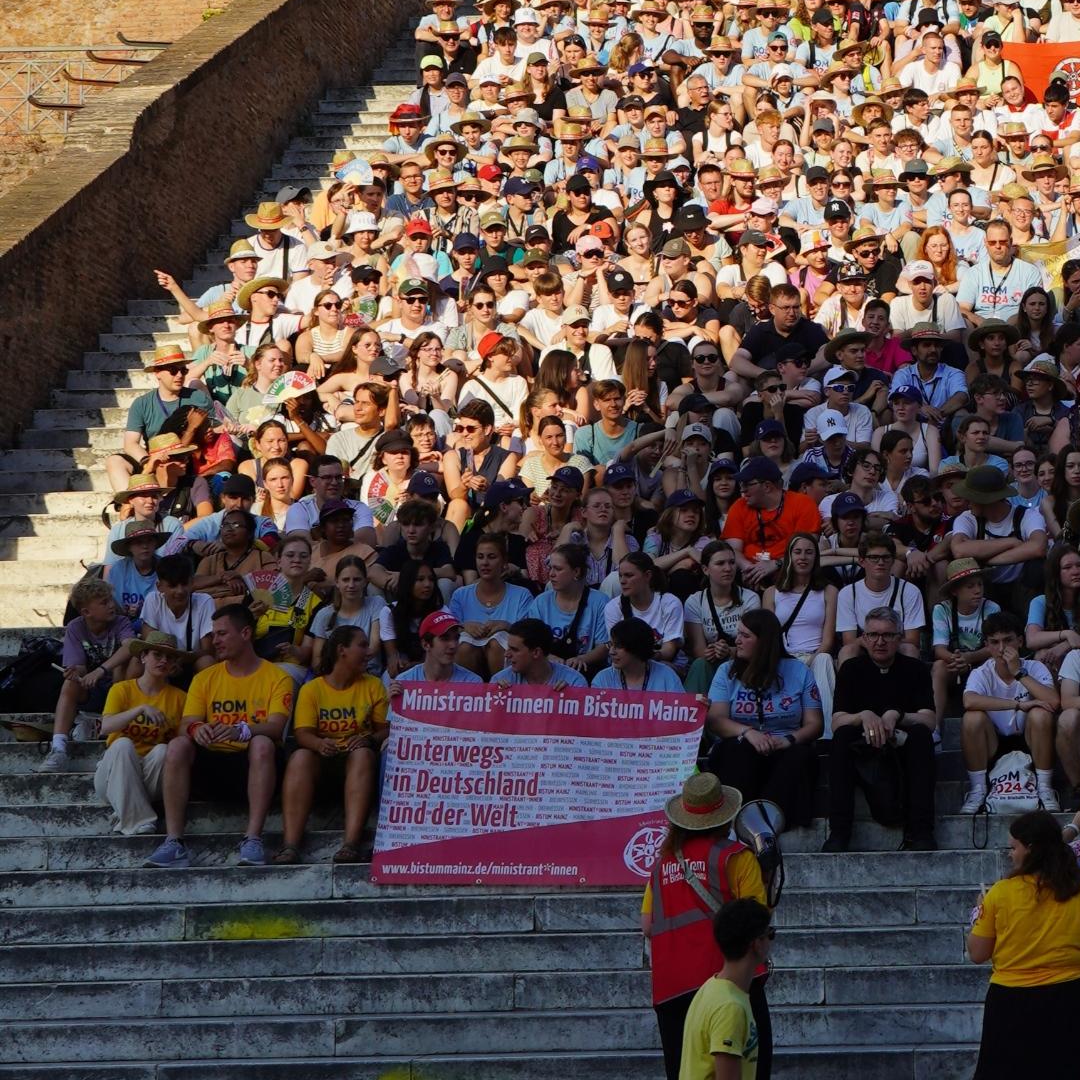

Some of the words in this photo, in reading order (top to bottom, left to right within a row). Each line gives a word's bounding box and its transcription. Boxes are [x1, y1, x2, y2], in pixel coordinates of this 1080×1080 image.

[212, 700, 247, 713] ROM
[558, 693, 579, 716] im
[584, 695, 645, 720] Bistum
[648, 699, 699, 723] Mainz
[736, 701, 774, 714] 204
[212, 713, 249, 726] 2024
[320, 707, 357, 720] ROM
[320, 720, 359, 733] 2024
[397, 737, 505, 769] Unterwegs
[393, 767, 411, 792] in
[416, 769, 538, 797] Deutschland
[388, 800, 427, 825] und
[431, 801, 465, 826] der
[471, 803, 518, 828] Welt
